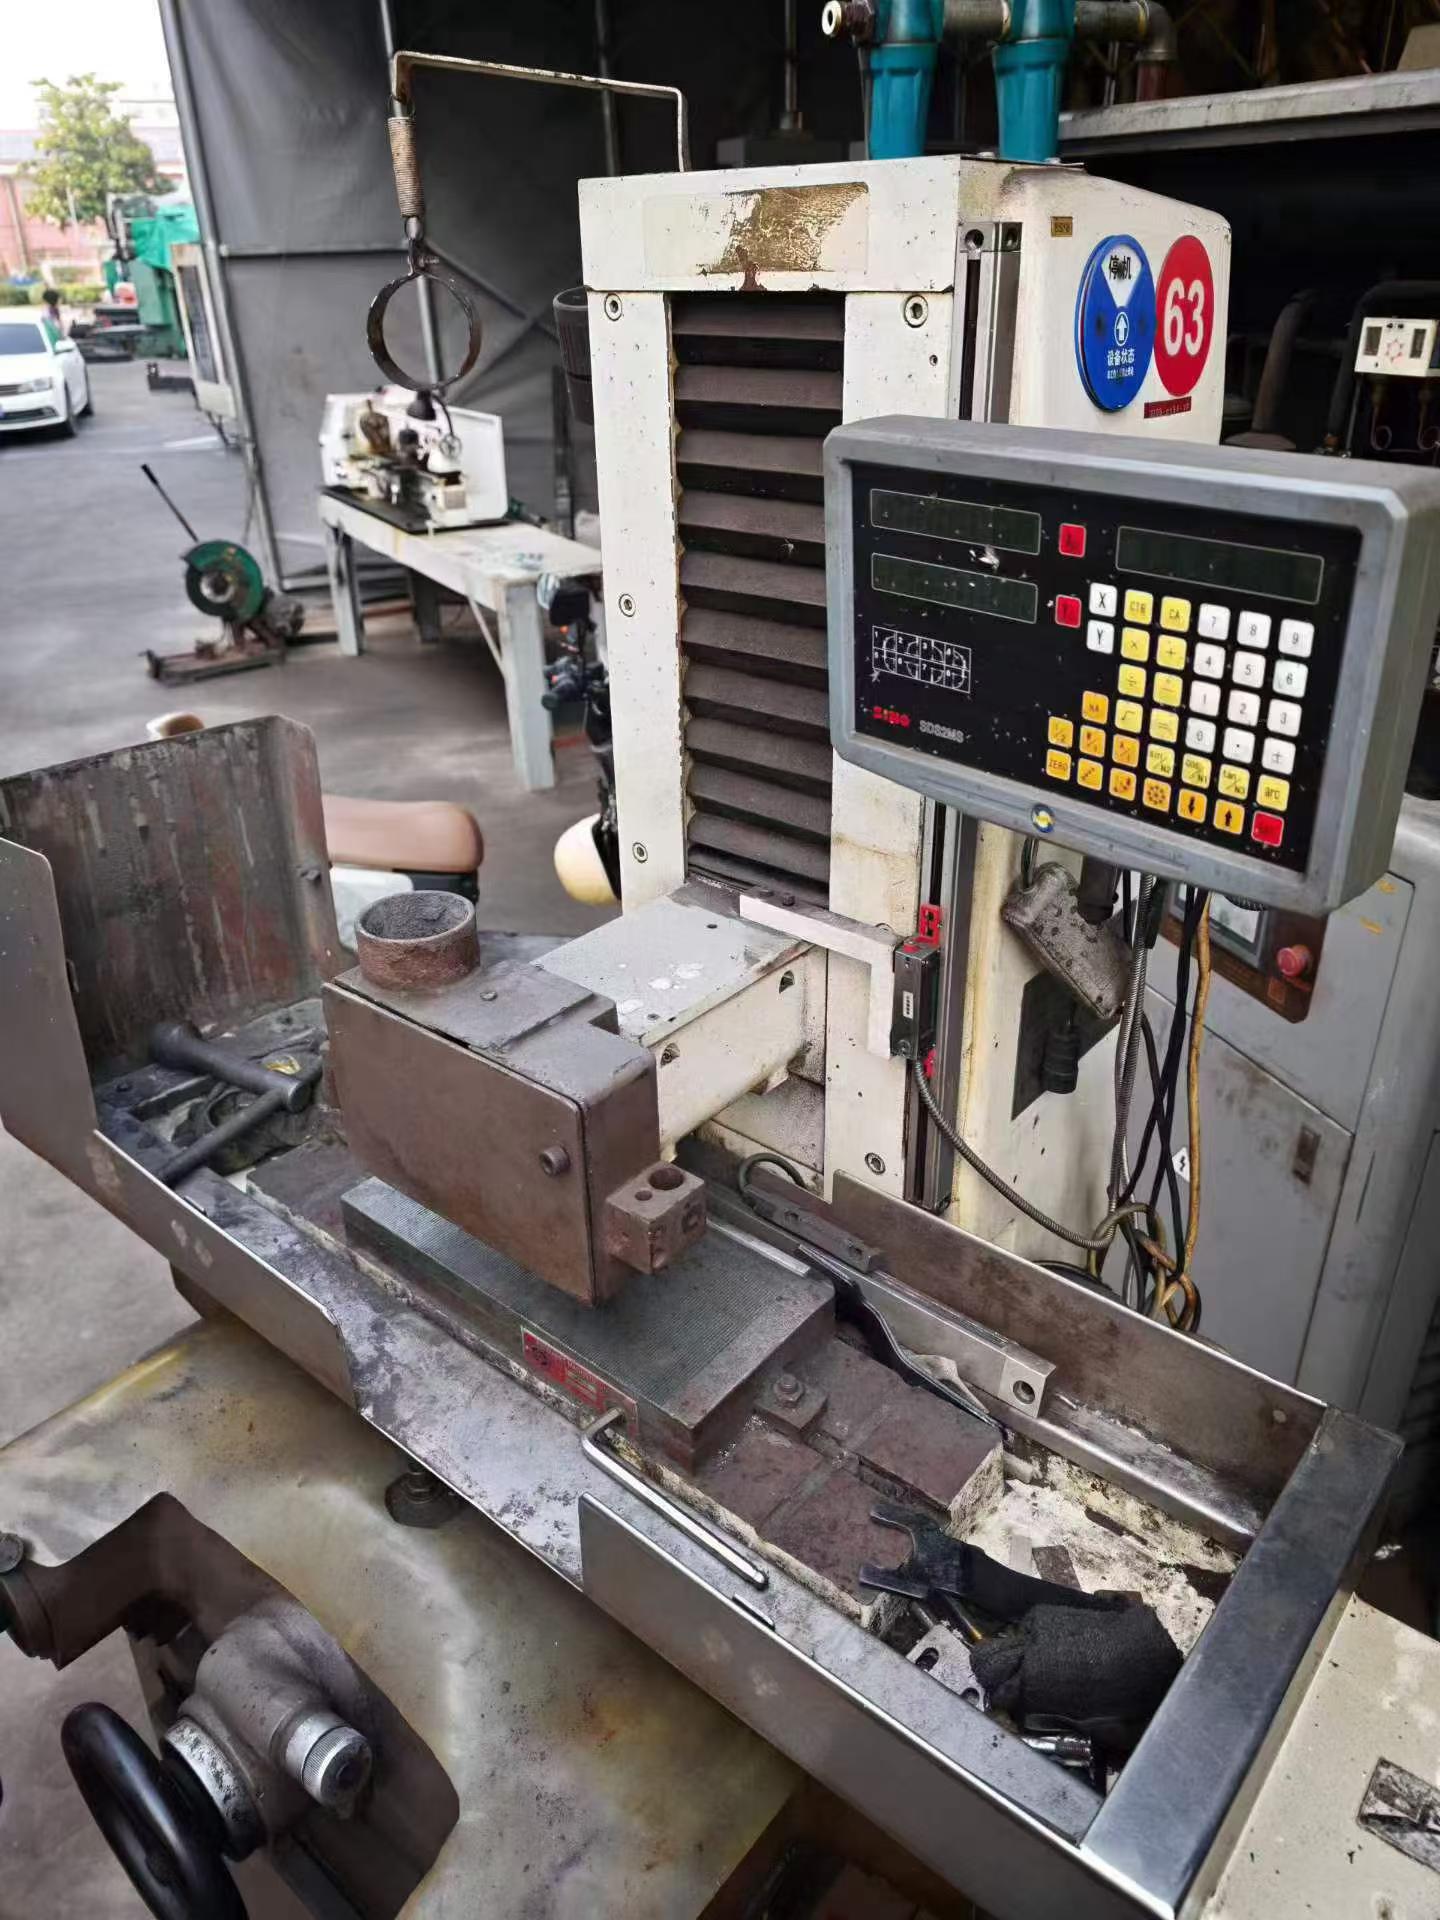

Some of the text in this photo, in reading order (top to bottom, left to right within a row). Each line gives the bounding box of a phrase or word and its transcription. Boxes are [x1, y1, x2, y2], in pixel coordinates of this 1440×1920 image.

[1164, 277, 1205, 357] 63
[1107, 348, 1135, 367] 设备状态
[1098, 591, 1106, 609] X
[1096, 627, 1104, 646] Y
[1249, 624, 1258, 637] 8
[1292, 632, 1300, 645] 9
[1244, 664, 1252, 676] 5
[1286, 673, 1293, 685] 6
[1239, 703, 1247, 715] 2
[1280, 712, 1287, 725] 3
